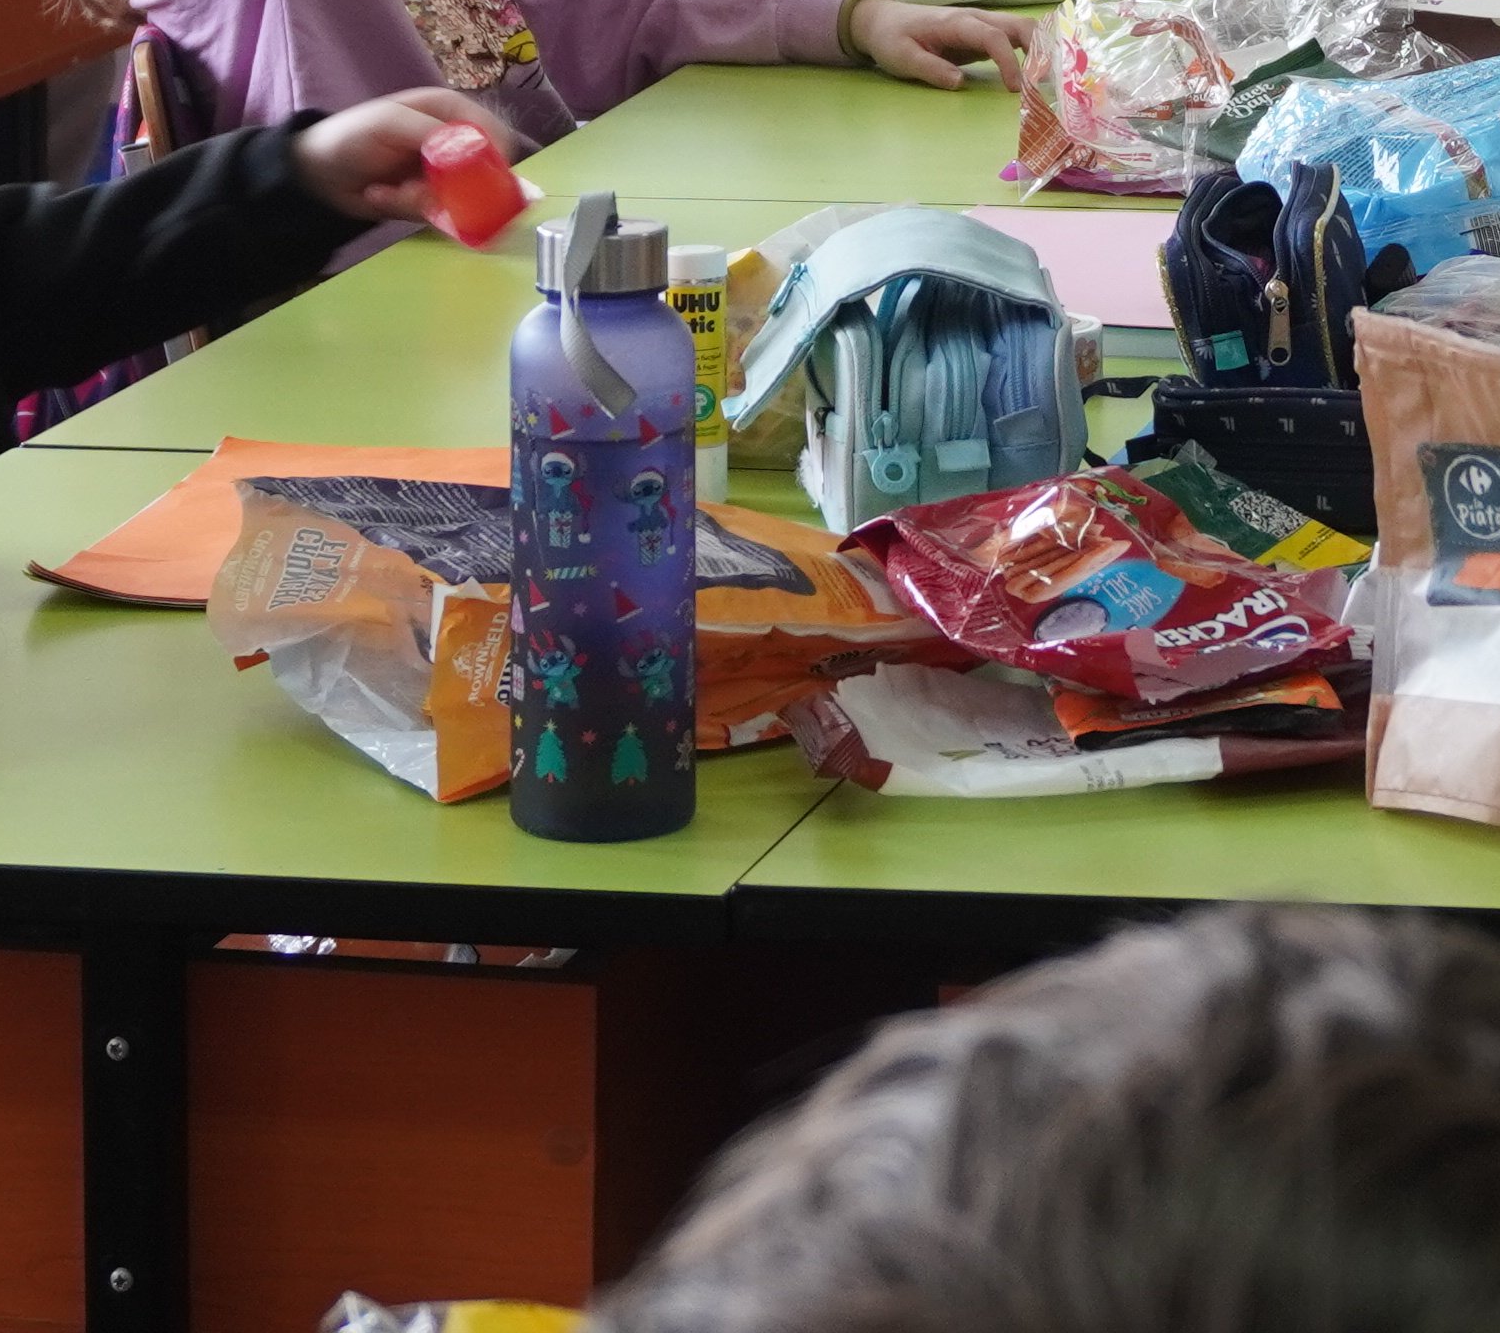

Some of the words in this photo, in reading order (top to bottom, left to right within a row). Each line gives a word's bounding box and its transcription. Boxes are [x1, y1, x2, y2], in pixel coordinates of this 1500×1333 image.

[672, 292, 722, 314] UHU
[692, 316, 715, 334] tic
[1132, 585, 1164, 623] SARE
